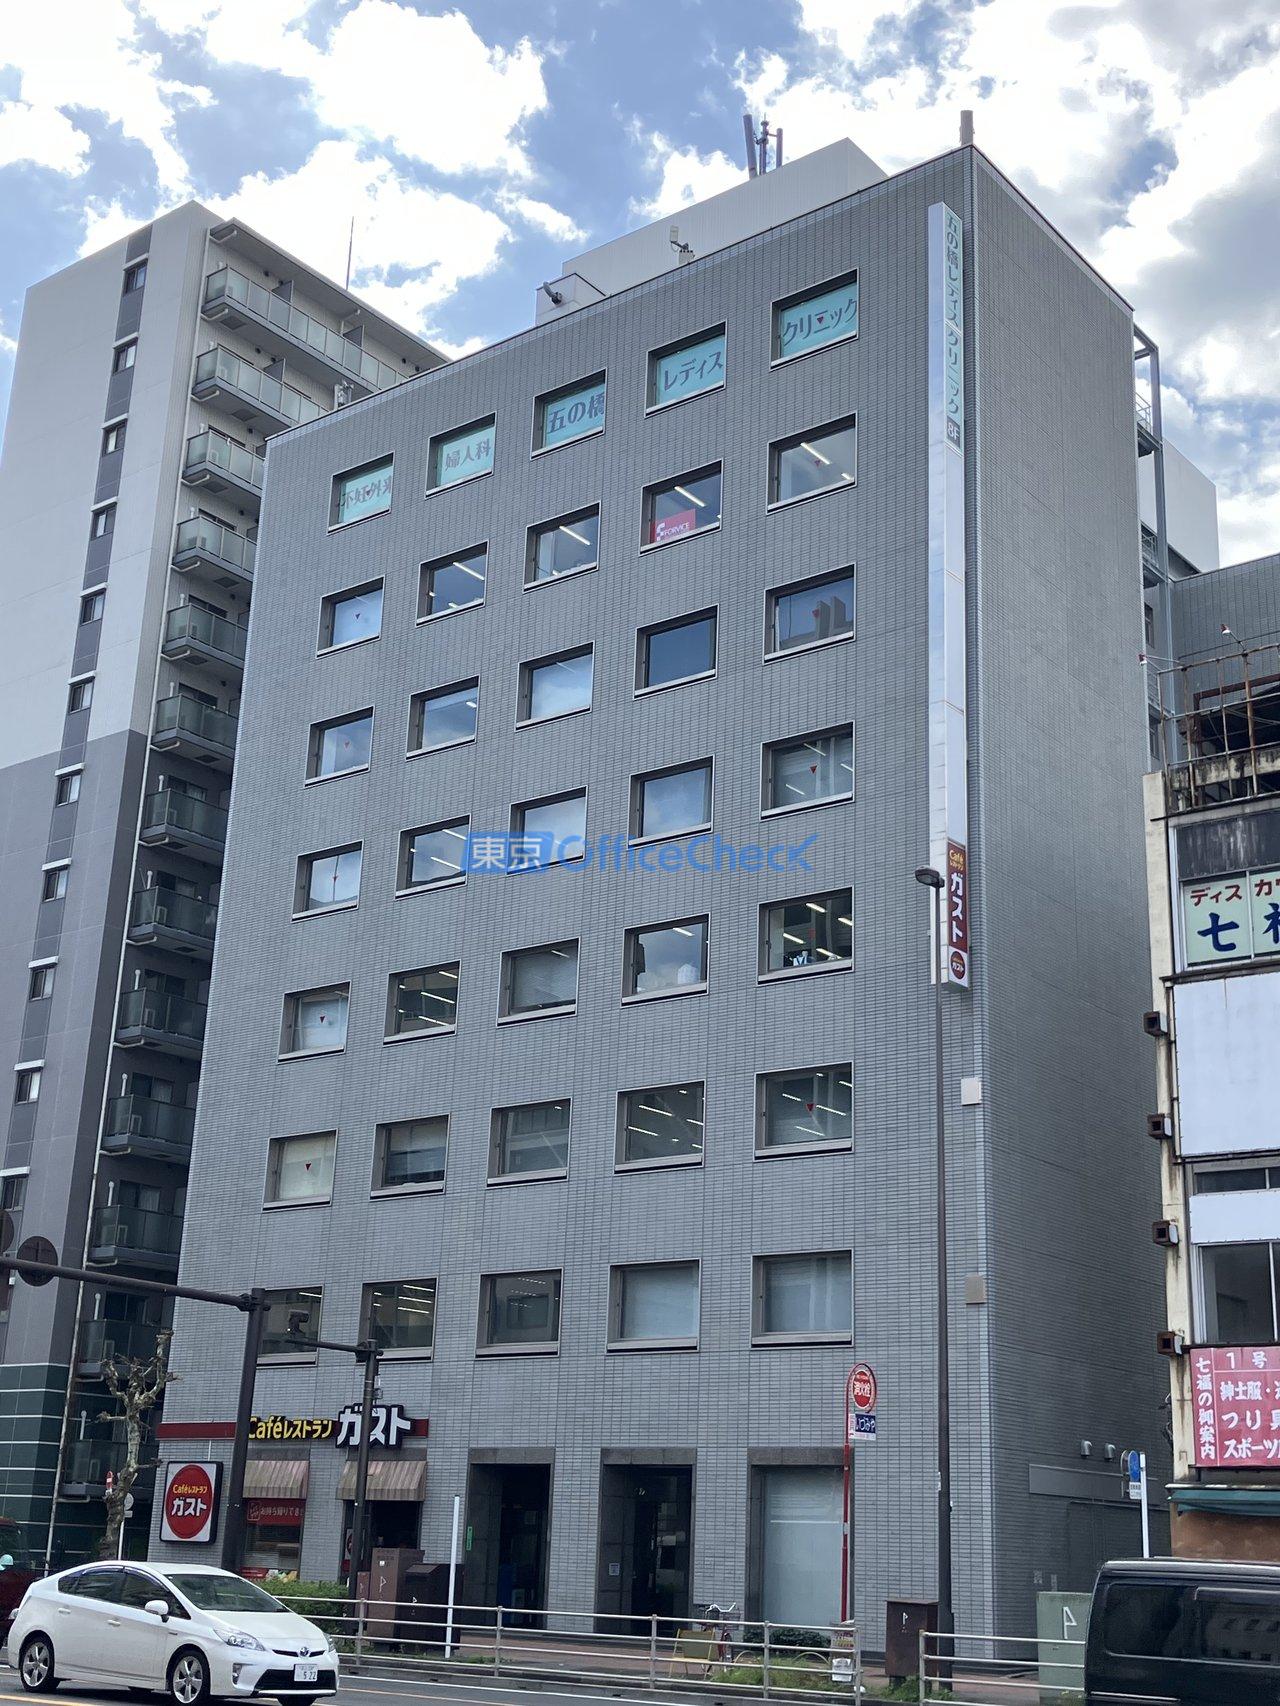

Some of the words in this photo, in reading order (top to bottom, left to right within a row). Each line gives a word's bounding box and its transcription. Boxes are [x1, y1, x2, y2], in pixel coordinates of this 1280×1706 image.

[782, 298, 858, 347] クリニック
[664, 351, 724, 391] レディス
[549, 391, 605, 433] 五の橋
[445, 438, 492, 471] 婦人科
[951, 872, 963, 943] ガスト
[1190, 879, 1280, 907] ディスカ
[336, 1406, 411, 1446] ガスト
[1196, 1357, 1216, 1460] 七福の御案内
[1223, 1437, 1280, 1459] スポーツ
[171, 1497, 207, 1516] ガスト
